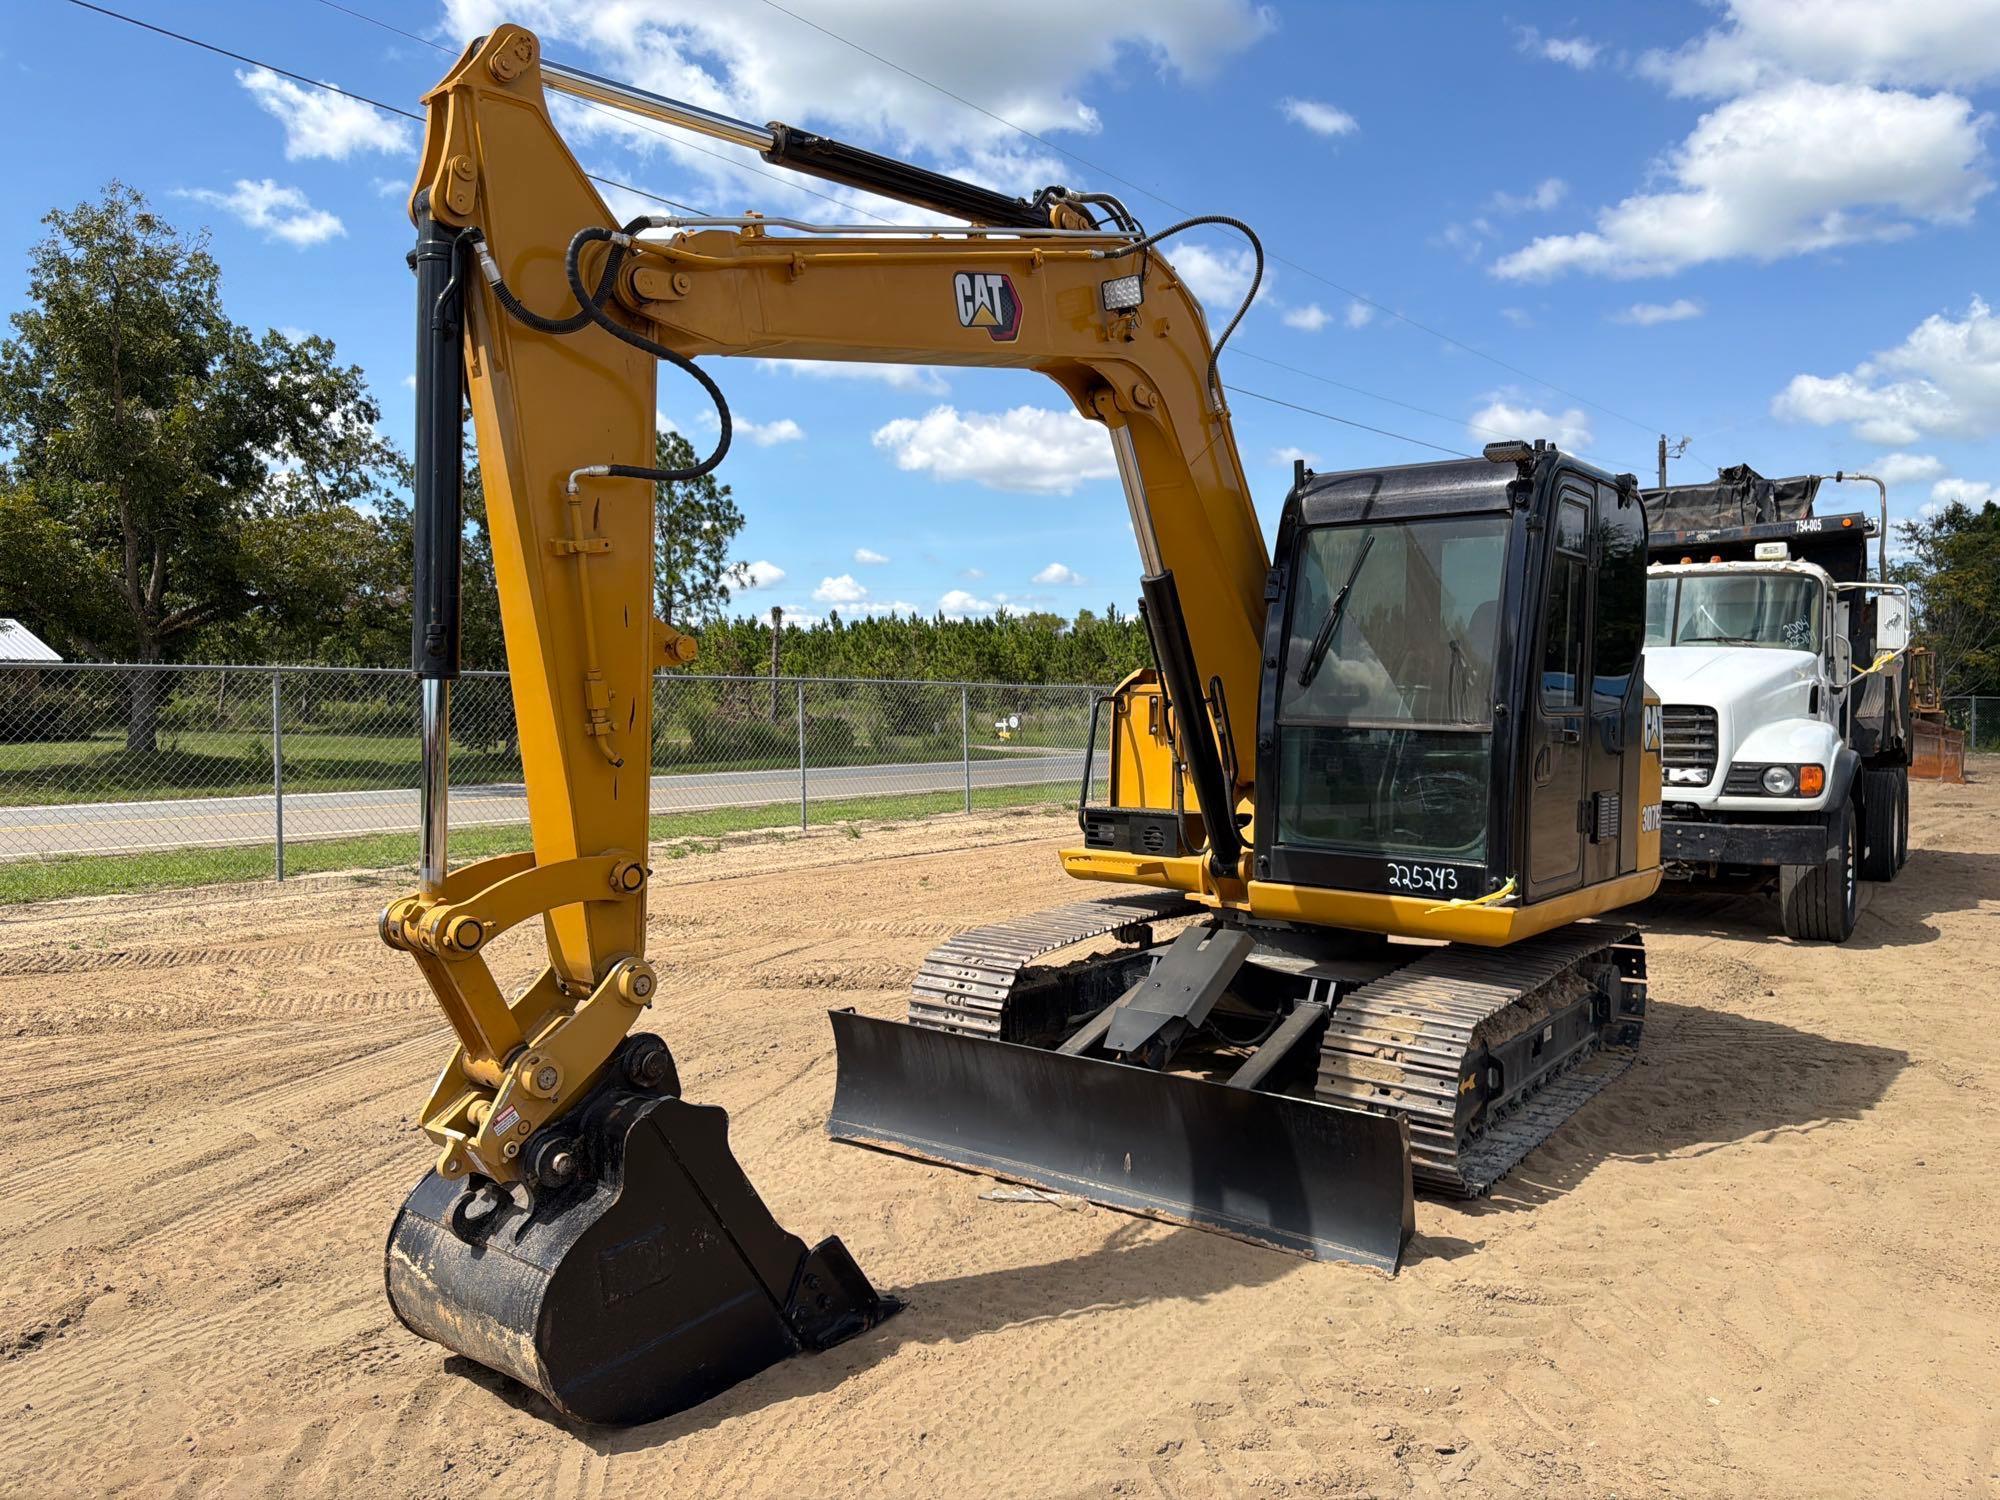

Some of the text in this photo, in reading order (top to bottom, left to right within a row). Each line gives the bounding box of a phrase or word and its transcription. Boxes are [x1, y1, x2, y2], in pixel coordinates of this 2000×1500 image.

[955, 273, 1003, 326] CAT
[1795, 518, 1822, 533] 754-005
[1783, 615, 1810, 638] 2004
[1387, 863, 1458, 891] 225243
